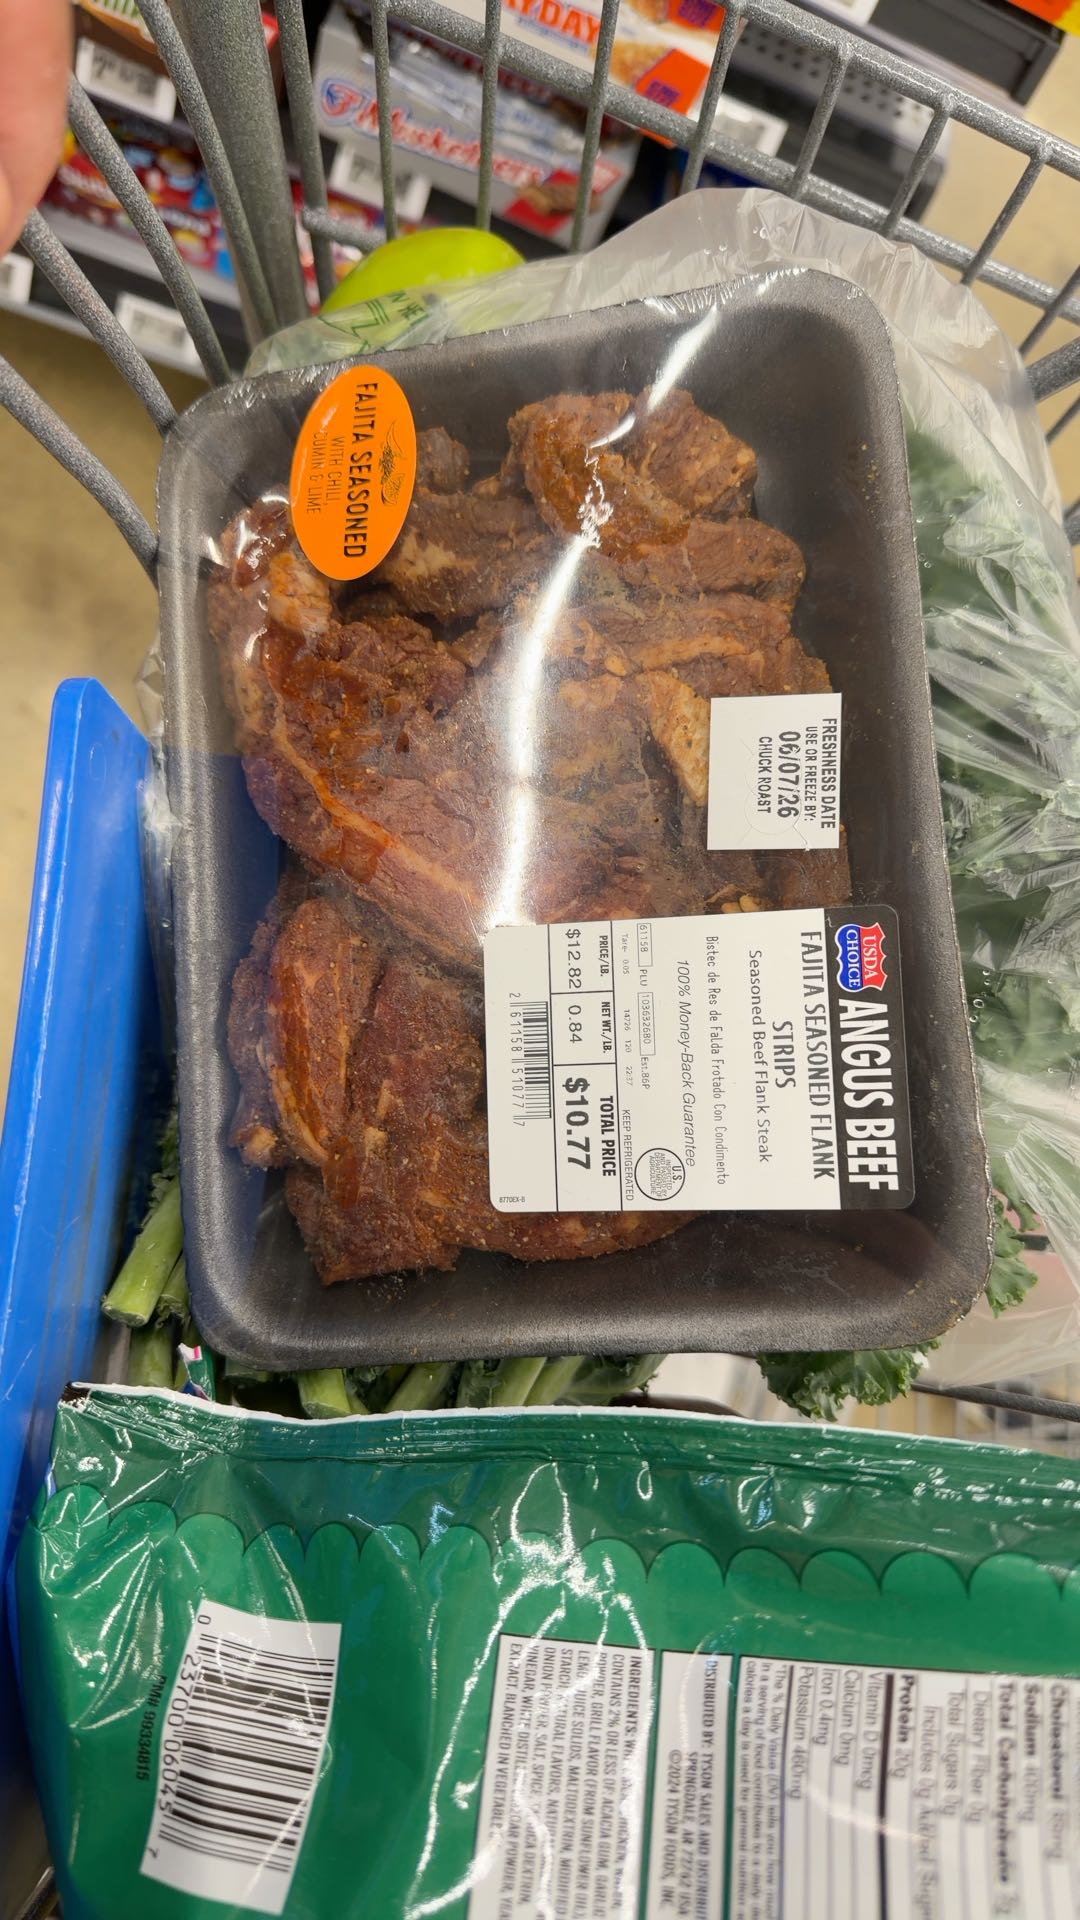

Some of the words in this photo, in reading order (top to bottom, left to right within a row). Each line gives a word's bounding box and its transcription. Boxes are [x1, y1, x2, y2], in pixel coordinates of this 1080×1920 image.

[352, 383, 378, 445] FAJITA
[310, 432, 328, 469] CUMIN
[329, 436, 345, 465] WITH
[306, 489, 321, 515] LIME
[344, 451, 373, 558] SEASONED
[758, 736, 772, 773] CHUCK
[805, 726, 818, 745] USE
[805, 749, 818, 762] OR
[821, 718, 837, 792] FRESHNESS
[777, 731, 801, 818] 06/07/26
[804, 765, 817, 802] FREEZE
[757, 777, 772, 814] ROAST
[804, 805, 817, 821] BY:
[821, 796, 836, 829] DATE
[598, 935, 610, 977] PRICE/LB.
[640, 924, 648, 952] 61158
[706, 936, 719, 967] Bistec
[862, 935, 878, 979] USDA
[565, 928, 582, 989] $12.82
[622, 959, 630, 974] 0.05
[640, 969, 648, 986] PLU
[677, 960, 692, 997] 100%
[708, 972, 720, 983] de
[801, 931, 825, 997] FAJITA
[846, 929, 861, 988] CHOICE
[708, 988, 722, 1005] Res
[749, 950, 766, 1025] Seasoned
[568, 1004, 582, 1044] 0.84
[601, 1002, 611, 1017] NET
[641, 994, 652, 1044] 103632680
[709, 1010, 722, 1022] de
[510, 1012, 522, 1052] 61158
[600, 1019, 612, 1054] WT./LB.
[677, 1001, 694, 1088] Money-Back
[710, 1026, 724, 1054] Falda
[753, 1031, 769, 1066] Beef
[772, 1021, 796, 1088] STRIPS
[804, 1003, 830, 1106] SEASONED
[838, 999, 894, 1108] ANGUS
[512, 1068, 524, 1108] 51077
[711, 1059, 726, 1098] Frotado
[755, 1071, 771, 1114] Flank
[562, 1077, 591, 1170] $10.77
[600, 1096, 615, 1135] TOTAL
[622, 1109, 631, 1132] KEEP
[682, 1092, 696, 1167] Guarantee
[714, 1104, 726, 1121] Con
[602, 1139, 616, 1176] PRICE
[715, 1126, 730, 1185] Condimento
[757, 1119, 773, 1162] Steak
[810, 1114, 835, 1179] FLANK
[844, 1118, 899, 1190] BEEF
[622, 1135, 634, 1201] REFRIGERATED
[654, 1152, 662, 1189] DEPARTMENT
[672, 1166, 682, 1184] U.S.
[196, 1614, 212, 1626] 0
[522, 1644, 540, 1693] VINEGAR,
[541, 1647, 556, 1680] ONION
[556, 1648, 574, 1690] STARCH,
[590, 1652, 608, 1699] POWDER,
[608, 1654, 625, 1707] CONTAINS
[744, 1660, 758, 1704] calories
[761, 1662, 772, 1672] in
[821, 1668, 838, 1695] Iron
[166, 1654, 201, 1728] 23700
[572, 1689, 588, 1718] JUICE
[624, 1655, 642, 1737] INGREDIENTS:
[702, 1660, 718, 1728] DISTRIBUTED
[754, 1685, 769, 1726] serving
[794, 1666, 814, 1741] Potassium
[842, 1669, 860, 1728] Calcium
[865, 1672, 884, 1726] Vitamin
[898, 1674, 916, 1743] Protein
[948, 1689, 966, 1726] Total
[998, 1682, 1017, 1729] Total
[498, 1693, 518, 1750] BLANCHED
[588, 1702, 604, 1732] GRILL
[607, 1710, 620, 1728] 2%
[740, 1716, 753, 1738] day
[754, 1728, 766, 1740] of
[770, 1707, 784, 1734] Daily
[812, 1700, 835, 1746] 0.4mg
[864, 1730, 879, 1742] D
[968, 1691, 991, 1748] Dietary
[136, 1711, 157, 1782] 99334815
[531, 1732, 548, 1760] SALT,
[568, 1720, 584, 1762] SOLIDS,
[585, 1734, 602, 1776] FLAVOR
[606, 1730, 620, 1746] OR
[702, 1731, 714, 1748] BY:
[834, 1732, 857, 1766] 0mg
[920, 1706, 942, 1773] Includes
[158, 1738, 180, 1815] 06045
[497, 1753, 511, 1765] IN
[546, 1745, 565, 1796] FLAVORS,
[603, 1748, 618, 1776] LESS
[668, 1750, 682, 1794] ©2024
[700, 1753, 714, 1790] TYSON
[786, 1745, 808, 1800] 460mg
[856, 1746, 878, 1790] 0mcg
[940, 1732, 965, 1791] Sugars
[971, 1754, 990, 1794] Fiber
[489, 1767, 509, 1828] VEGETABLE
[582, 1778, 598, 1816] (FROM
[602, 1778, 616, 1795] OF:
[682, 1751, 698, 1824] SPRINGDALE,
[560, 1765, 580, 1853] MALTODEXTRIN,
[600, 1797, 614, 1838] ACACIA
[665, 1798, 680, 1835] TYSON
[699, 1792, 712, 1826] SALES
[575, 1818, 595, 1890] SUNFLOWER
[595, 1841, 612, 1871] GUM,
[681, 1829, 694, 1845] AR
[698, 1830, 711, 1856] AND
[500, 1840, 518, 1893] POWDER,
[518, 1851, 536, 1904] DEXTRIN,
[662, 1838, 678, 1880] FOODS,
